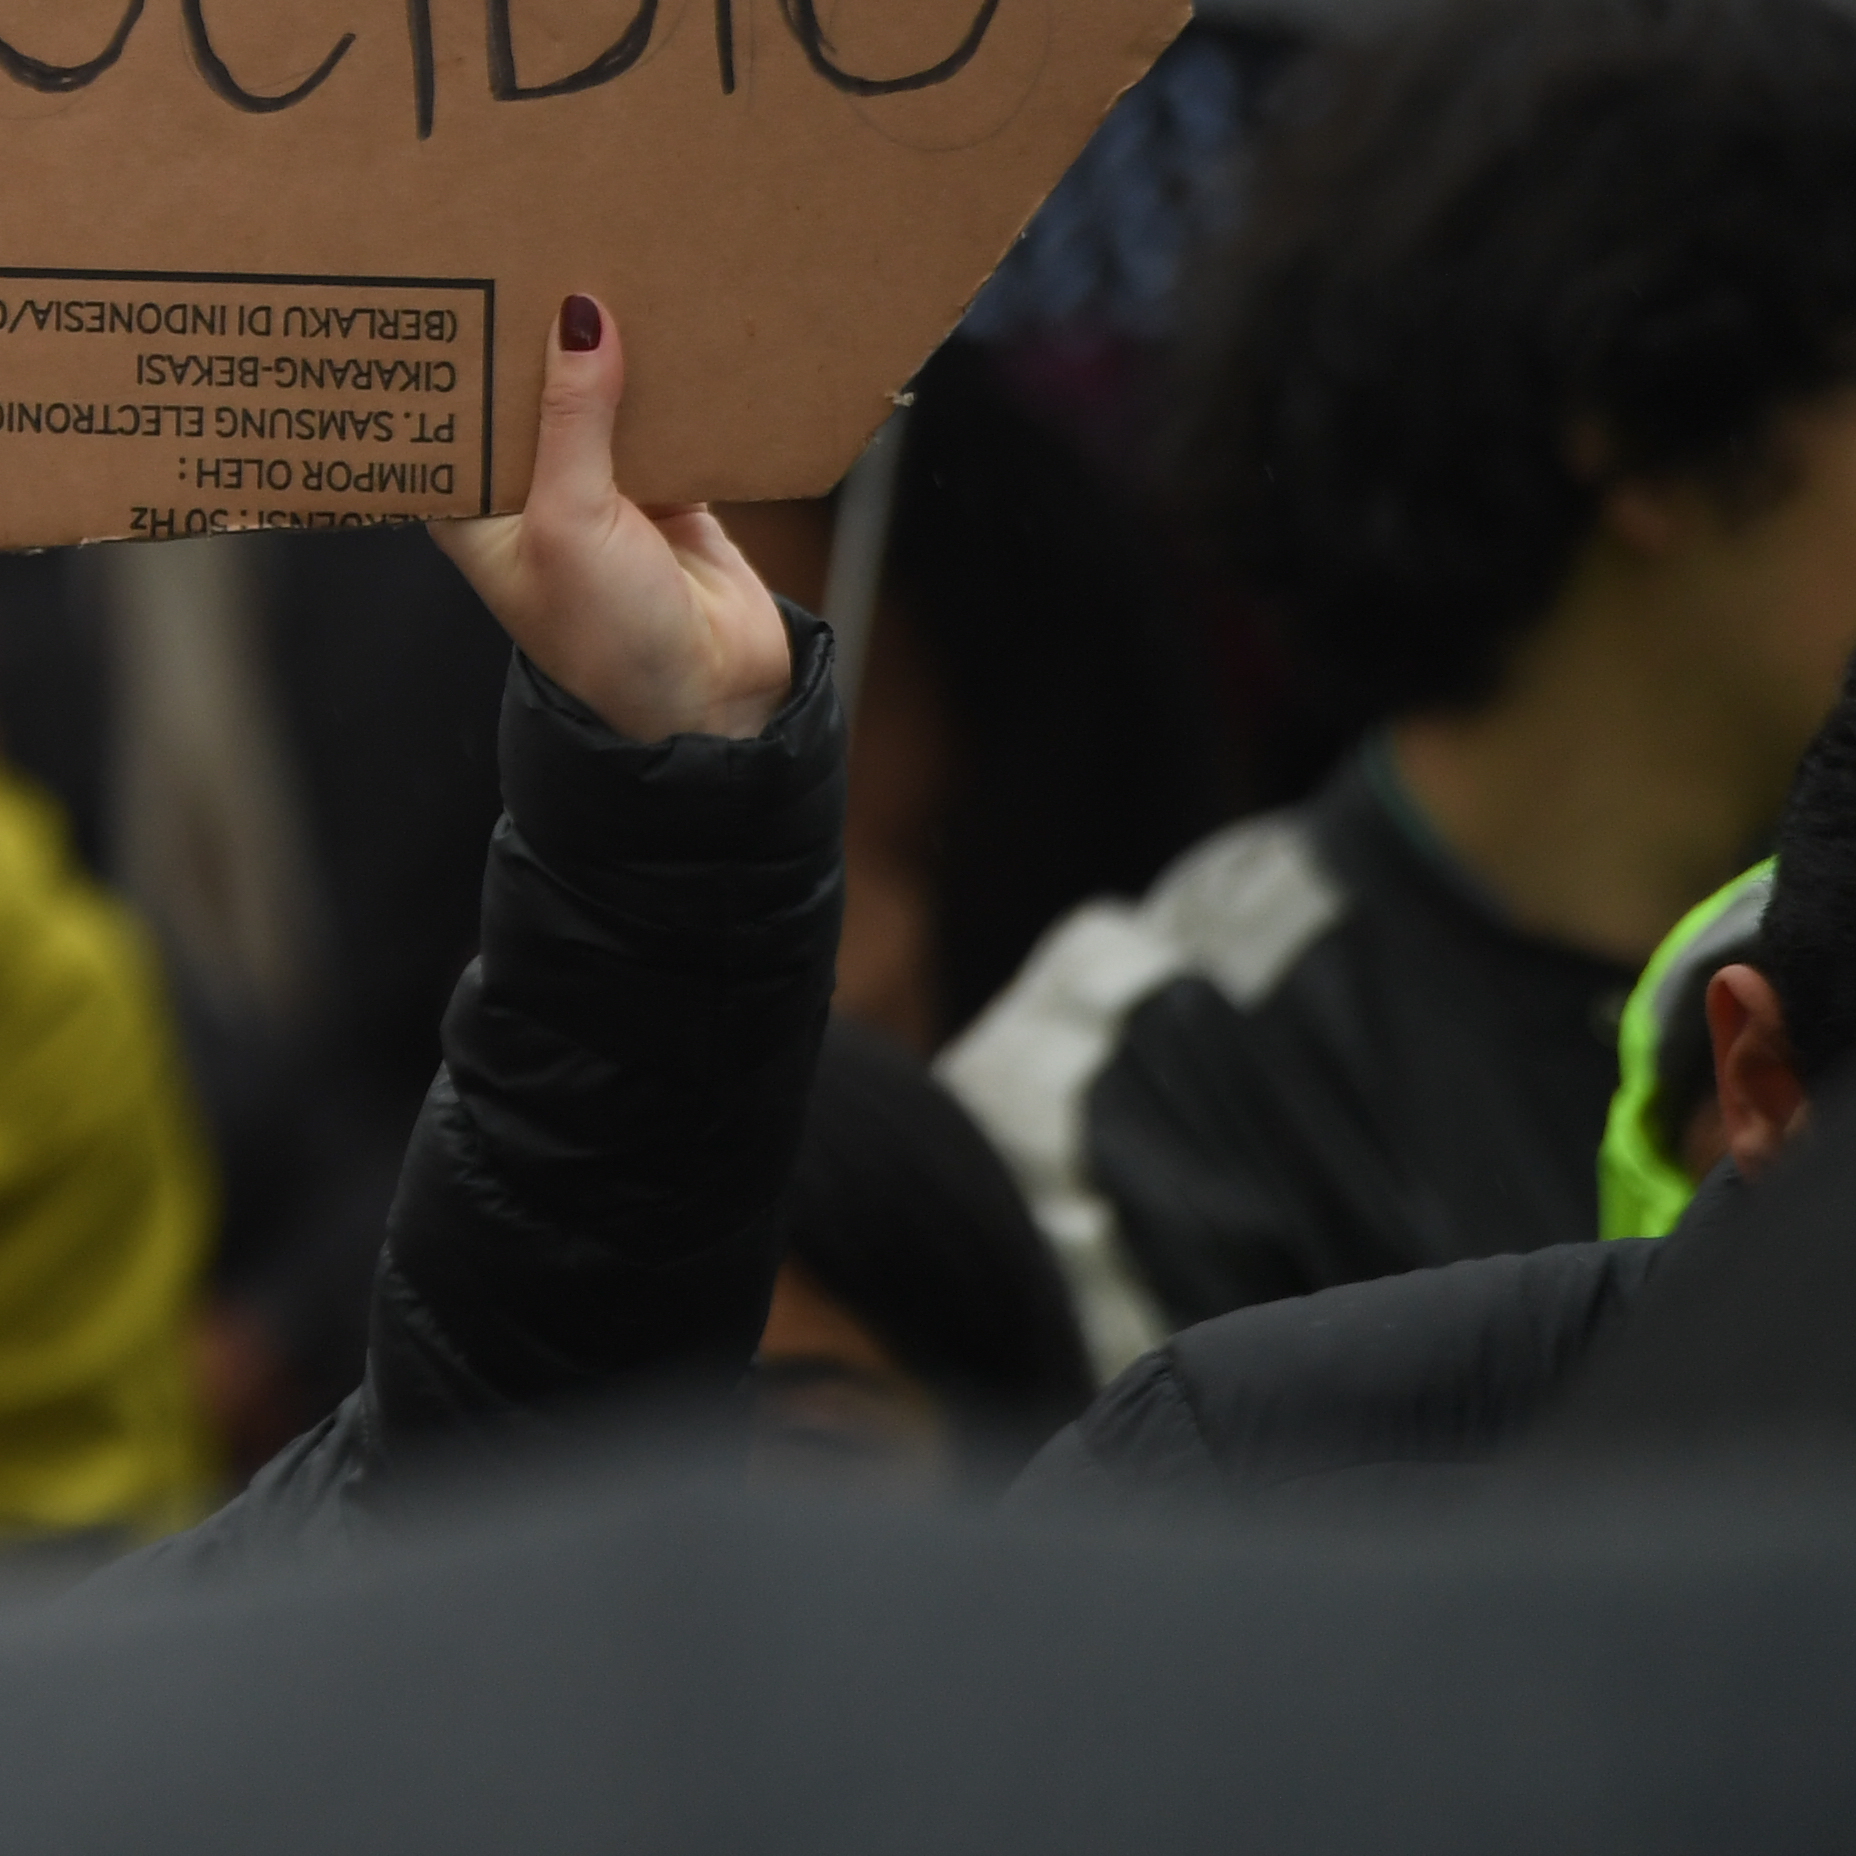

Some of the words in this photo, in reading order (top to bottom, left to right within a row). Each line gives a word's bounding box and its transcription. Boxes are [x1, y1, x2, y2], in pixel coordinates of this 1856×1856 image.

[238, 305, 272, 337] DI
[283, 306, 457, 343] (BERLAKU
[137, 354, 457, 393] CIKARANG-BEKASI
[216, 408, 394, 441] SAMSUNG
[402, 411, 455, 443] PT.
[301, 462, 454, 494] DIIMPOR
[130, 507, 174, 537] Hz
